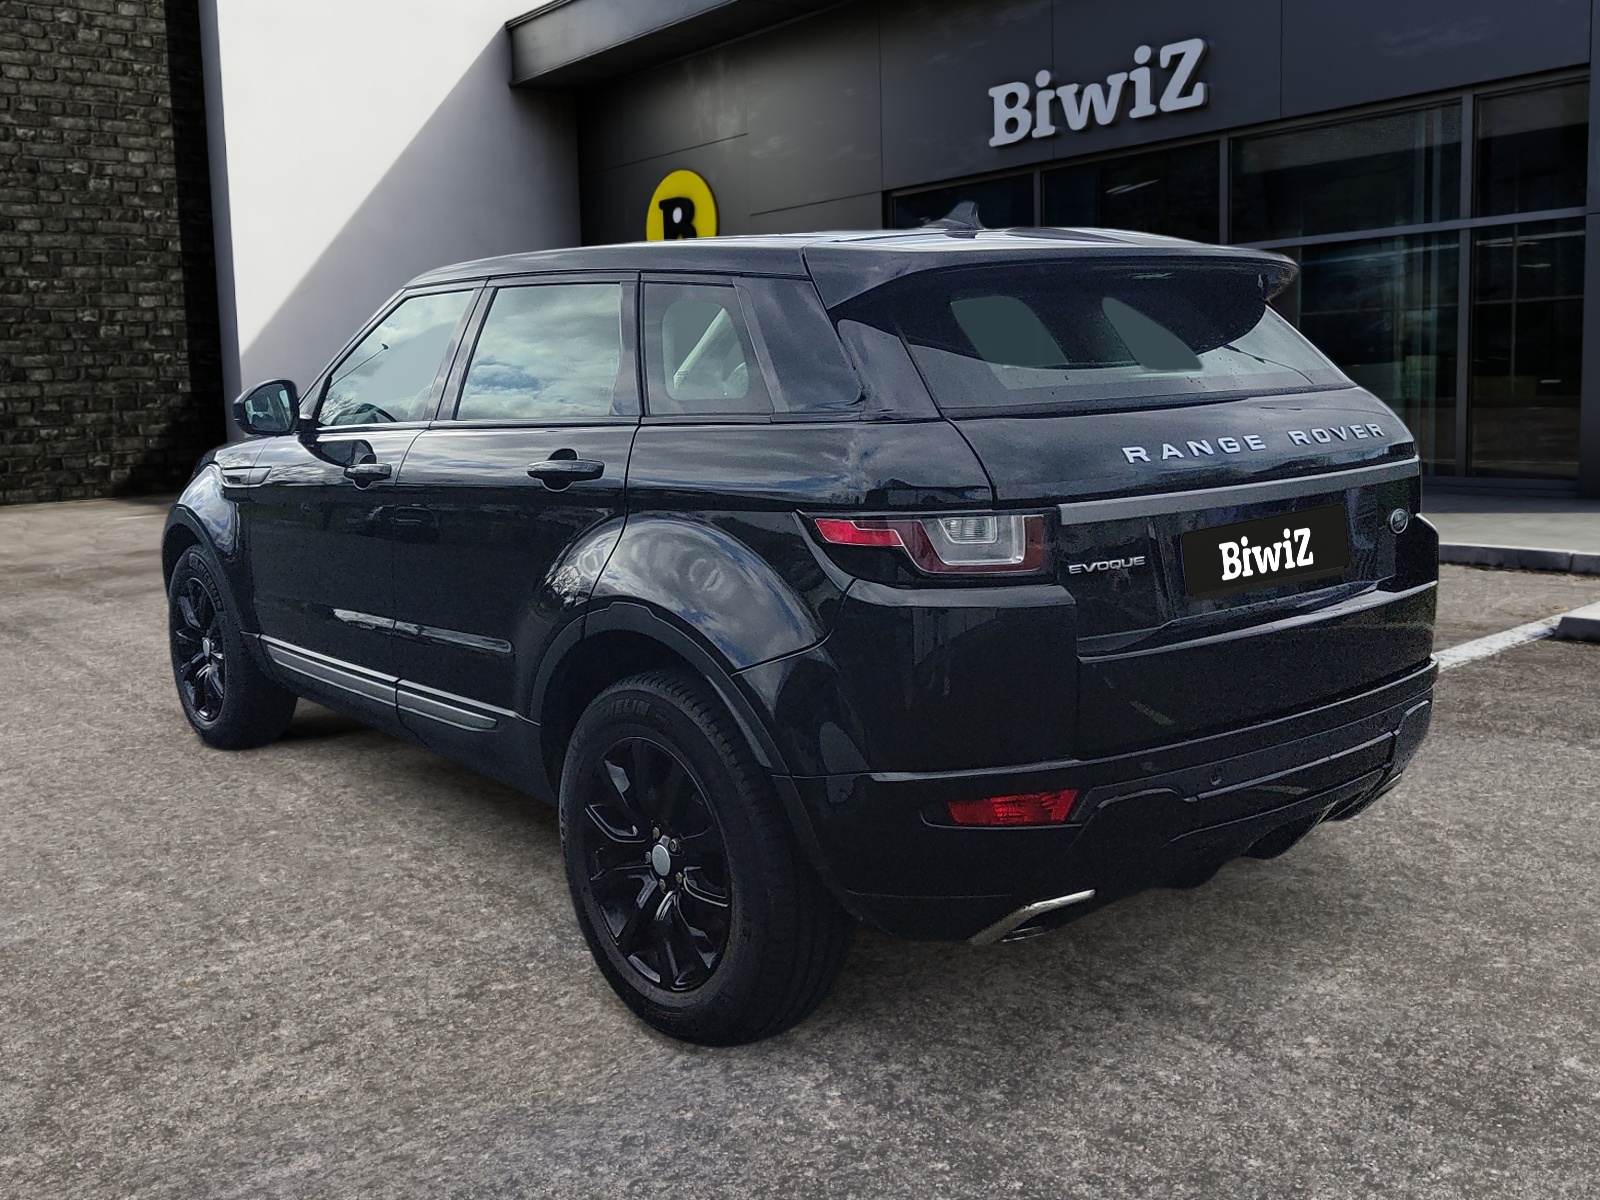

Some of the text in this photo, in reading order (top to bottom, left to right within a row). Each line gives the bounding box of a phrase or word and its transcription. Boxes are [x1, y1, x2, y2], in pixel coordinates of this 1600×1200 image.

[1121, 423, 1386, 464] RANGE ROVER
[1068, 556, 1146, 574] EVOQUE
